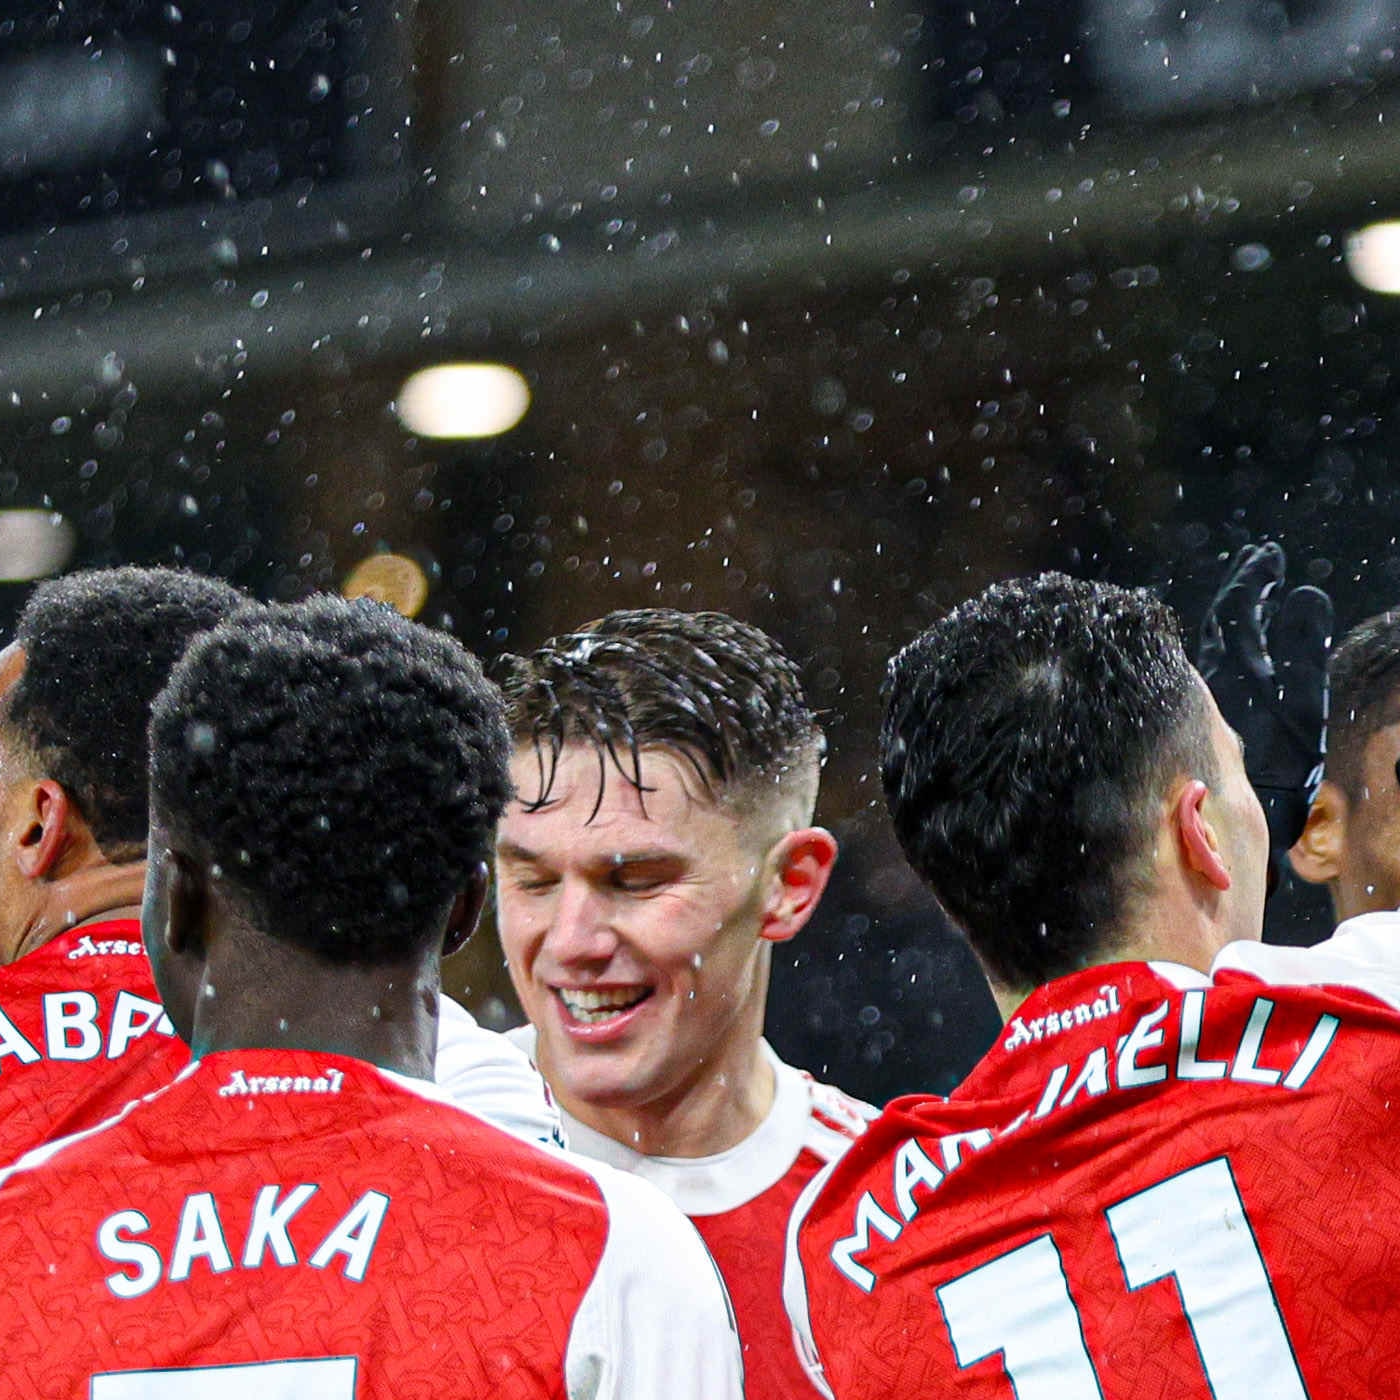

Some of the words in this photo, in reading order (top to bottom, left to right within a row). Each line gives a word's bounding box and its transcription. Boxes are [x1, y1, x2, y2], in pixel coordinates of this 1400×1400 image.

[67, 934, 149, 960] Arse
[1004, 985, 1120, 1050] Arsenal
[218, 1067, 345, 1097] Arsenal
[96, 1183, 392, 1299] SAKA
